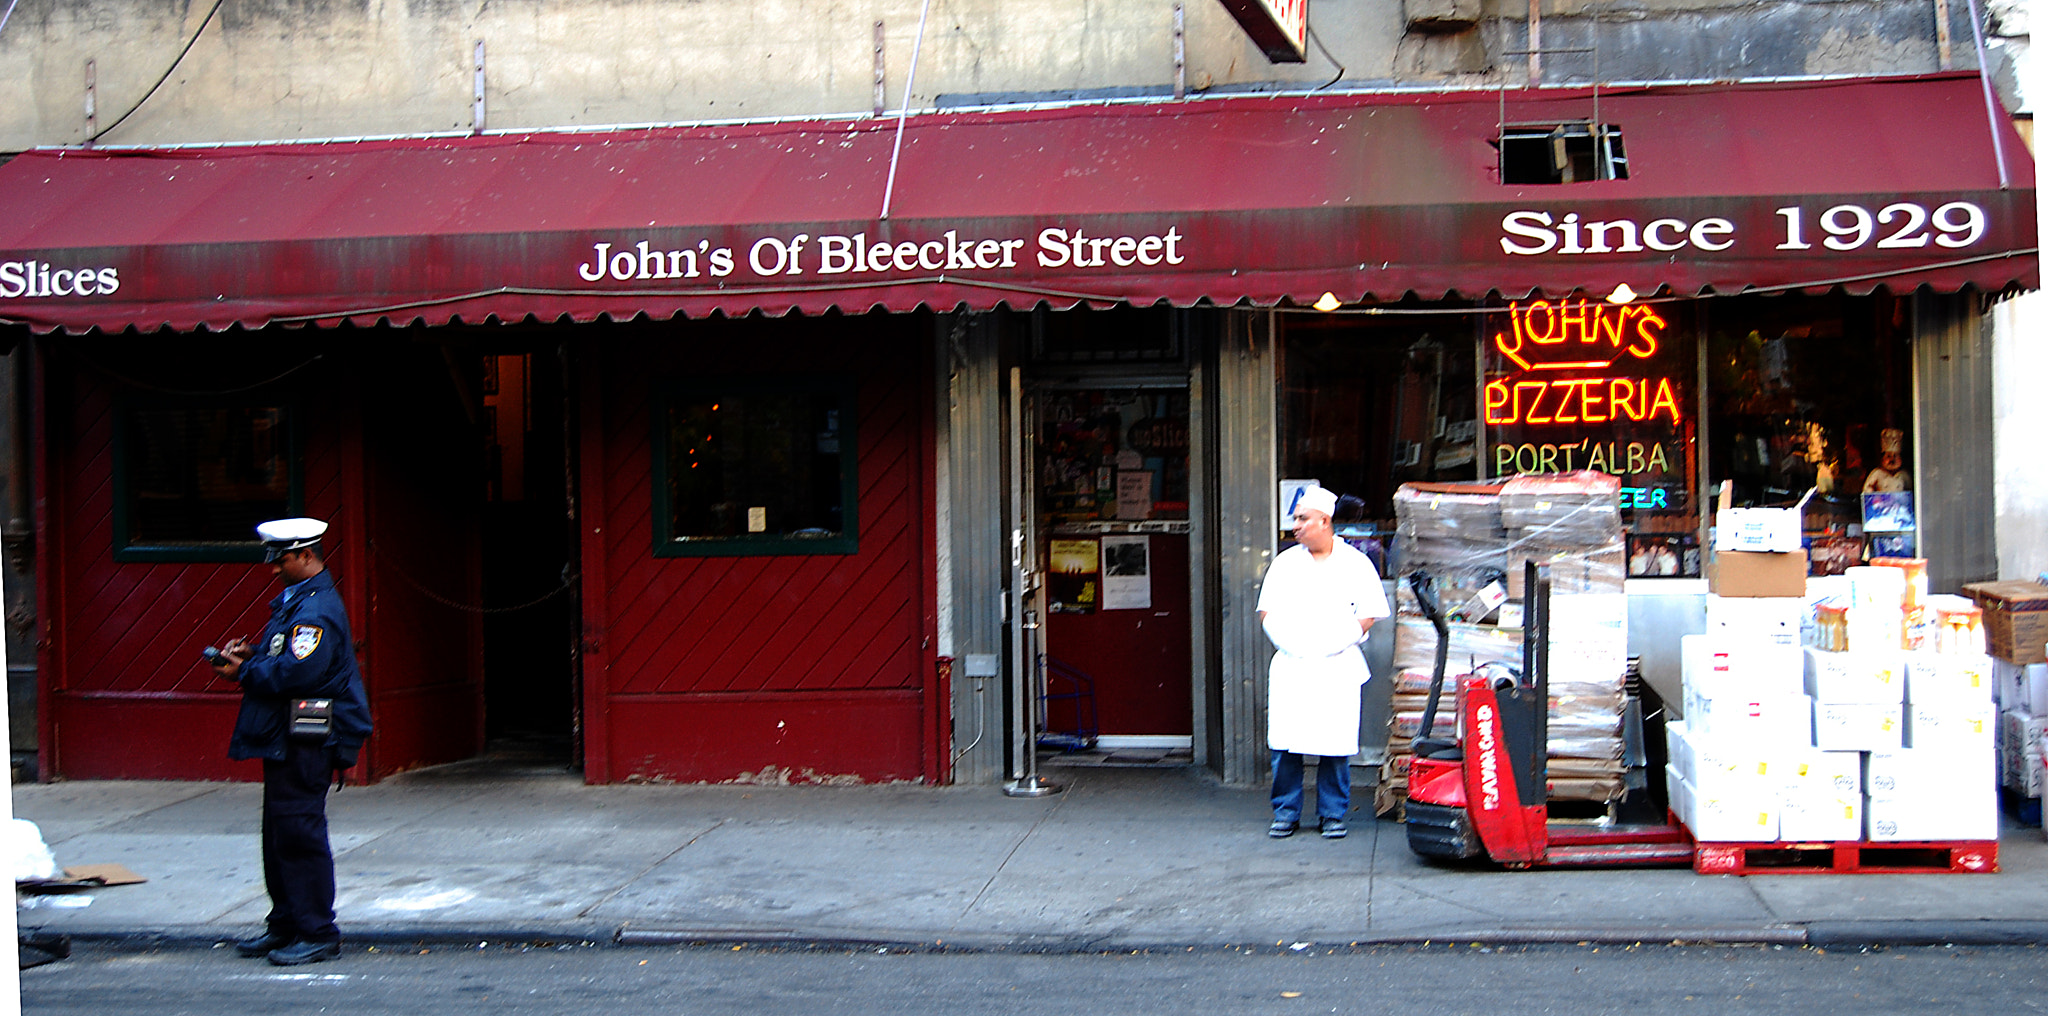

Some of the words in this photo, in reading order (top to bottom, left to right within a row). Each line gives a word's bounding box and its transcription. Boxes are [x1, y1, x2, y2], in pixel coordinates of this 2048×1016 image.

[579, 239, 735, 282] John's
[749, 233, 809, 276] Of
[816, 228, 1025, 274] Bleecker
[1036, 225, 1185, 268] Street
[1499, 211, 1735, 255] Since
[1775, 201, 1986, 251] 1929
[0, 261, 120, 298] Slices
[1495, 298, 1668, 360] JOHN'S
[1484, 378, 1682, 426] PIZZERIA
[1496, 437, 1669, 477] PORT'ALBA
[1619, 487, 1668, 509] EER
[1476, 704, 1499, 811] RAYMOND
